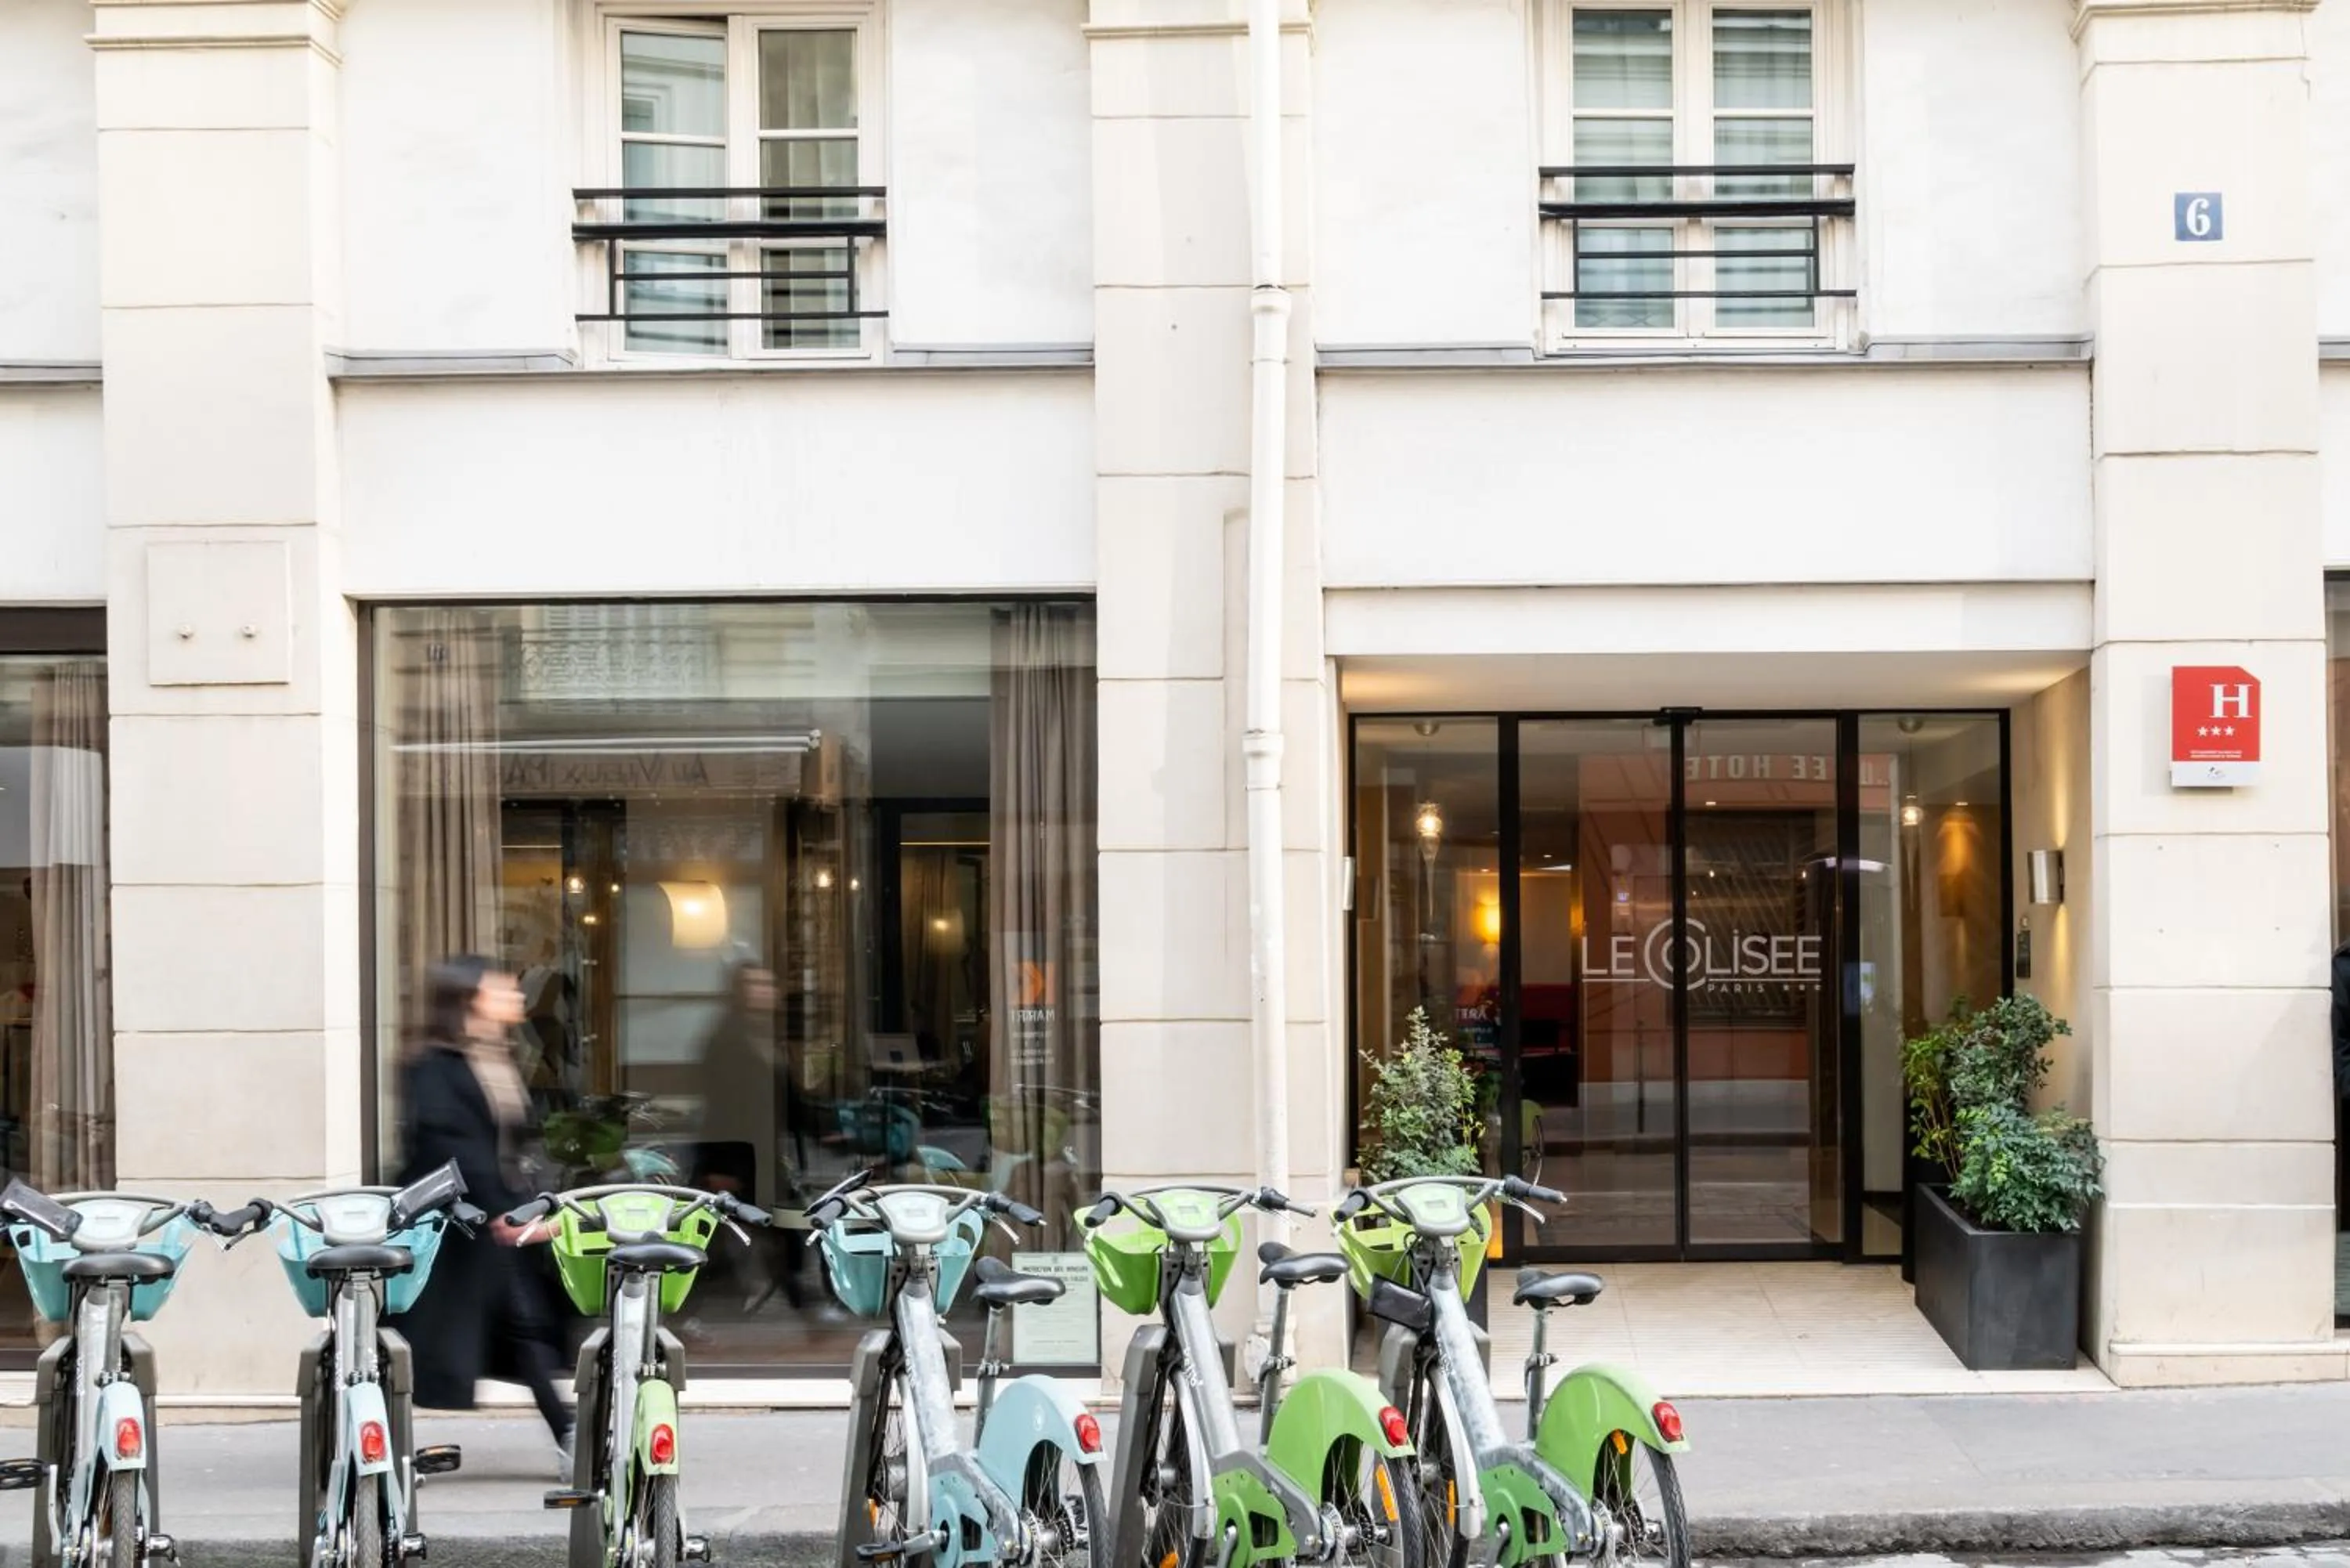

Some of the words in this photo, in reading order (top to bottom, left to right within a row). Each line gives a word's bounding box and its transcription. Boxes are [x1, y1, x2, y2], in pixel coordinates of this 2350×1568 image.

[2186, 197, 2211, 236] 6
[2208, 684, 2253, 718] H
[1582, 936, 1636, 975] LE
[1706, 983, 1766, 993] PARIS
